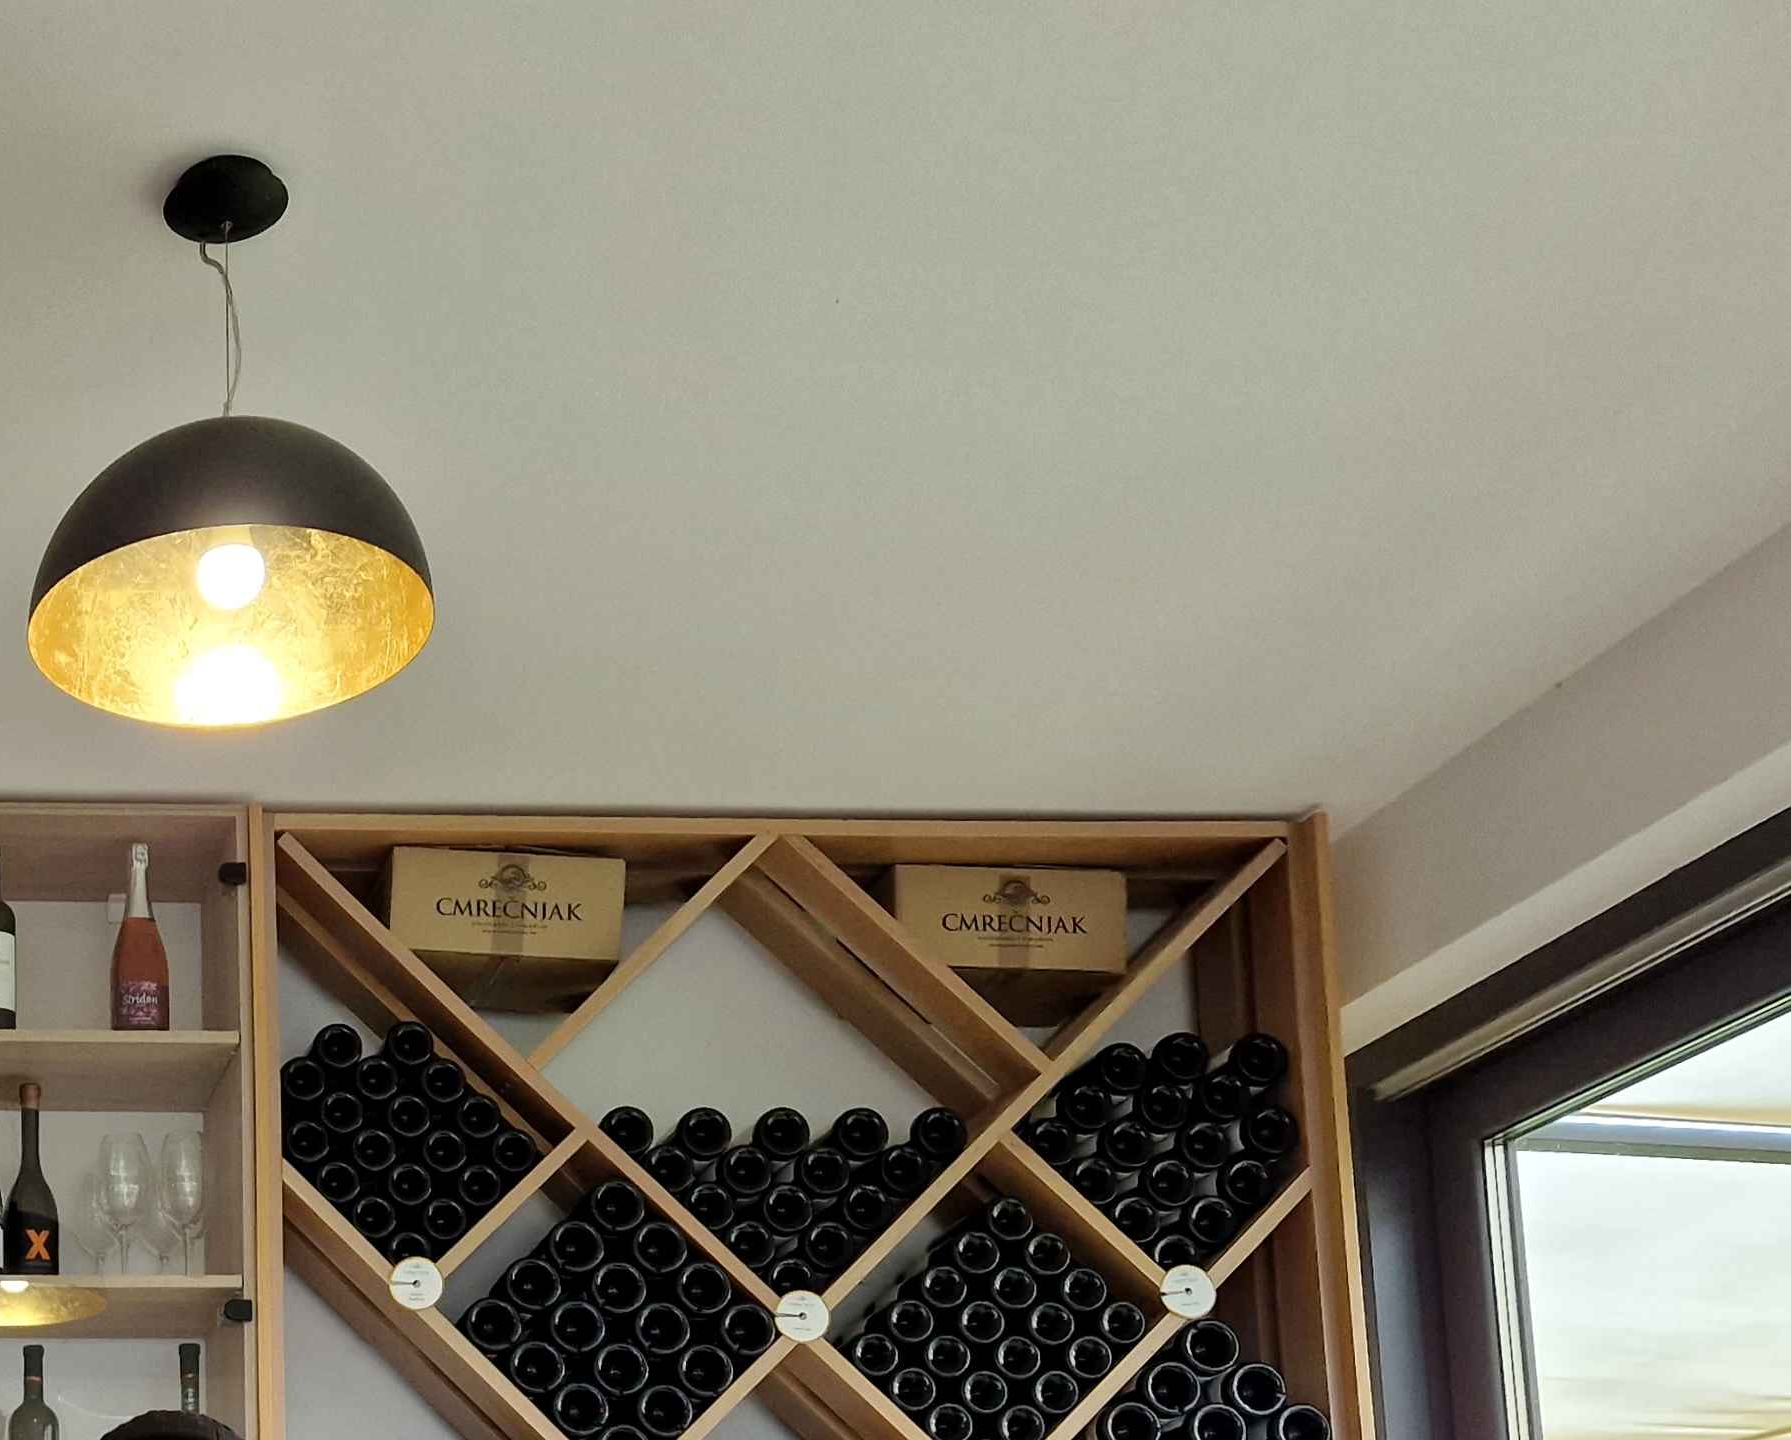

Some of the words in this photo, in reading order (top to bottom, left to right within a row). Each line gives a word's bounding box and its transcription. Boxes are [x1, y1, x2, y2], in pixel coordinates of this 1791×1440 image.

[435, 896, 584, 922] CMREČNJAK
[941, 909, 1089, 935] CMREČNJAK
[24, 1228, 51, 1261] X
